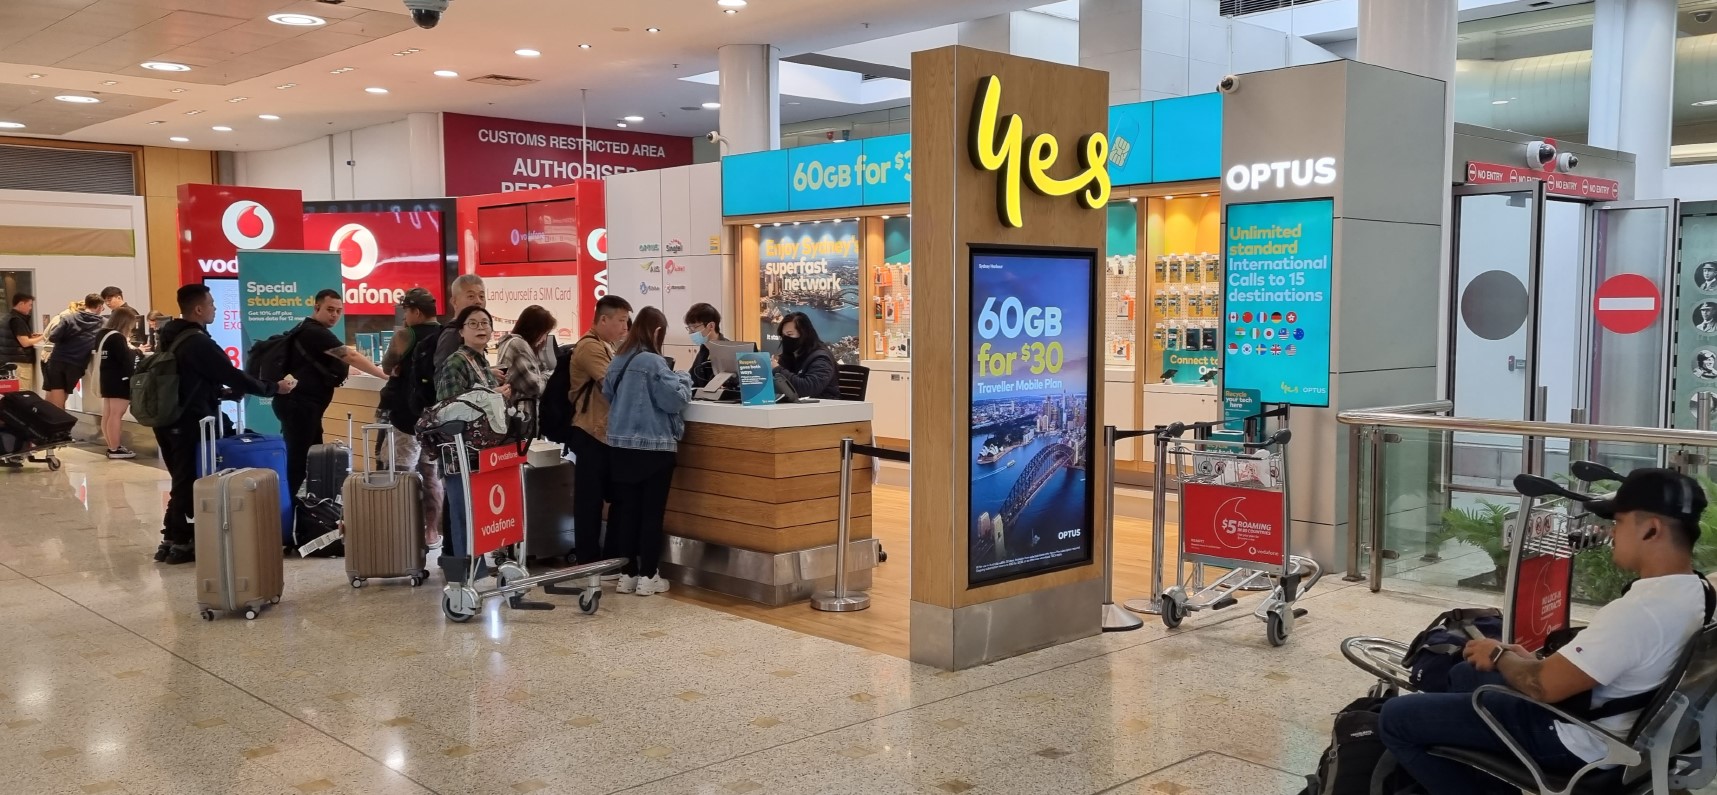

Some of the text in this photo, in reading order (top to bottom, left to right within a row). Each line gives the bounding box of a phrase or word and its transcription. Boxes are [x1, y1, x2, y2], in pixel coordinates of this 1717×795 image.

[478, 128, 666, 158] CUSTOMS RESTRICTED AREA
[513, 157, 639, 180] AUTHORIS
[793, 160, 851, 191] 60GB
[855, 155, 891, 185] for
[1226, 156, 1337, 191] OPTUS
[1478, 170, 1503, 181] NO ENTRY
[1556, 180, 1577, 190] NO ENTRY
[1590, 184, 1609, 194] NO ENTRY
[1229, 223, 1302, 240] Unlimited
[766, 235, 859, 260] Enjoy Sydney's
[1229, 239, 1299, 255] standard
[765, 256, 828, 279] superfast
[1229, 254, 1328, 271] International
[784, 273, 841, 291] network
[1229, 271, 1305, 287] Calls to 15
[246, 281, 297, 295] Special
[487, 287, 571, 303] Land yourself a SIM Card
[1228, 287, 1323, 302] destinations
[247, 296, 300, 307] student
[977, 296, 1063, 339] 60GB
[977, 341, 1064, 377] for $30
[1170, 354, 1208, 365] Connect
[978, 378, 1063, 394] Traveller Mobile Plan
[498, 451, 518, 461] vodafone
[481, 517, 515, 536] vodafone
[1058, 528, 1081, 540] OPTUS
[1222, 518, 1272, 534] $5 ROAMING
